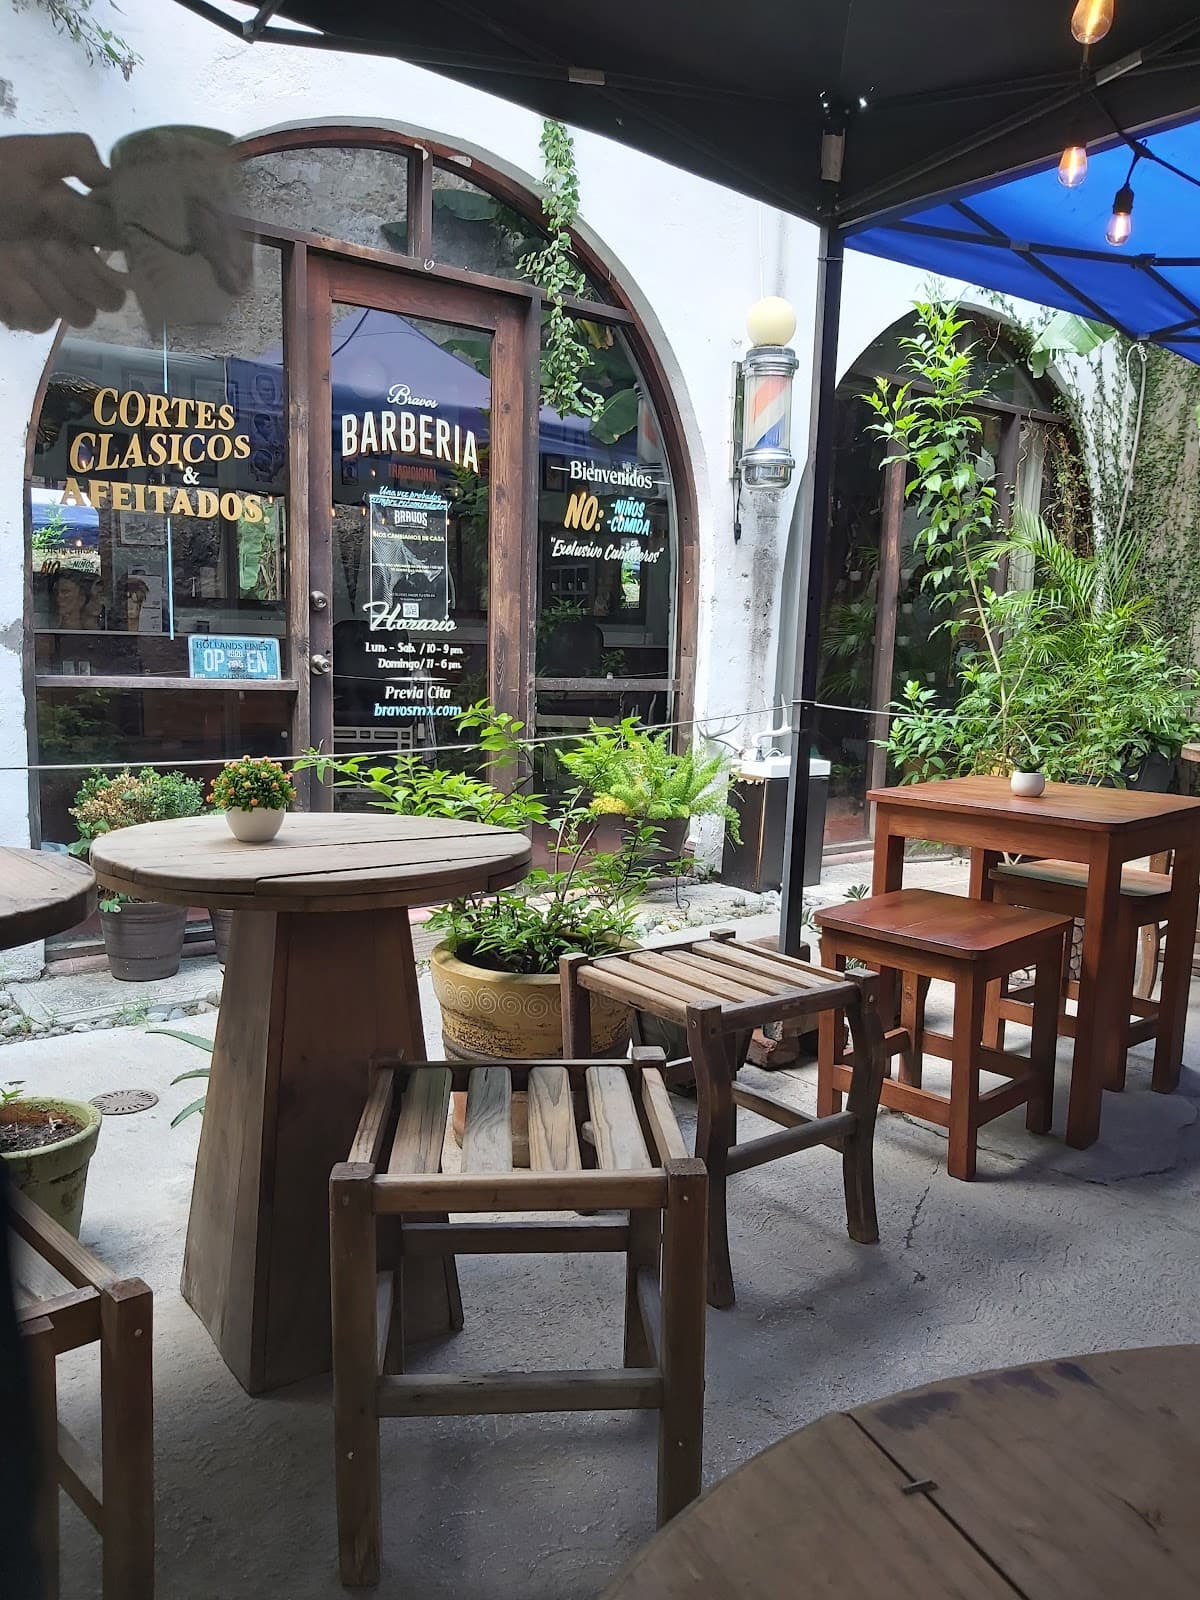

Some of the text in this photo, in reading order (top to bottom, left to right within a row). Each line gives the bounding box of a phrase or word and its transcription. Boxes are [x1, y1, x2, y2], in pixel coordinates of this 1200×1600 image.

[93, 387, 235, 431] CORTES
[387, 383, 439, 408] Bravos
[69, 432, 251, 473] CLASICOS
[341, 410, 480, 474] BARBERIA
[182, 466, 200, 485] &
[570, 460, 653, 489] Bienvenidos
[60, 477, 270, 524] AFEITADOS.
[563, 491, 605, 532] NO:
[363, 601, 457, 632] Horario
[385, 686, 451, 699] Previa Cita
[374, 703, 462, 717] bravosmx.com
